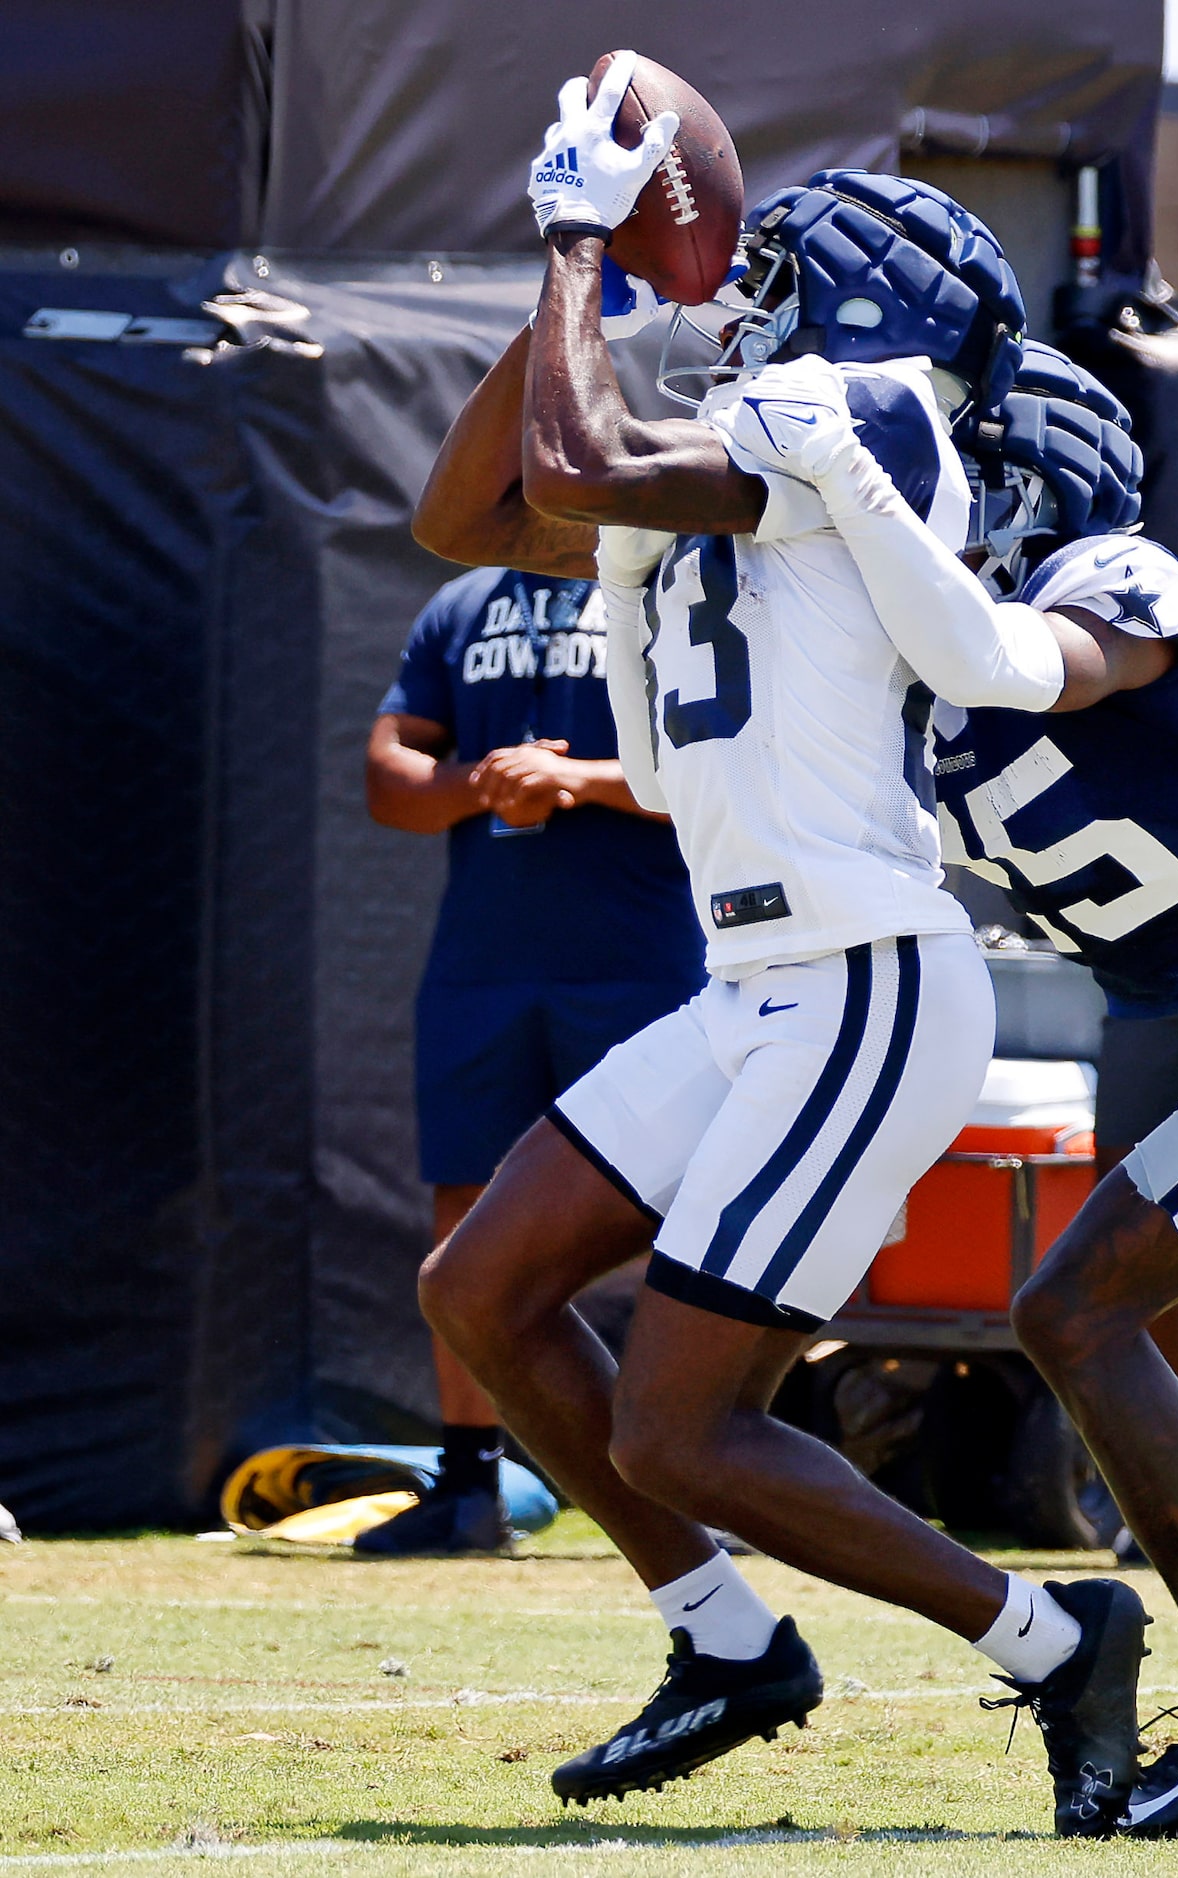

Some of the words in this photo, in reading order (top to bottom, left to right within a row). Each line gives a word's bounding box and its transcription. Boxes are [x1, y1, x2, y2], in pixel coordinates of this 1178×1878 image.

[536, 168, 585, 188] adidas
[463, 632, 608, 684] COWBOY
[642, 533, 752, 773] 3
